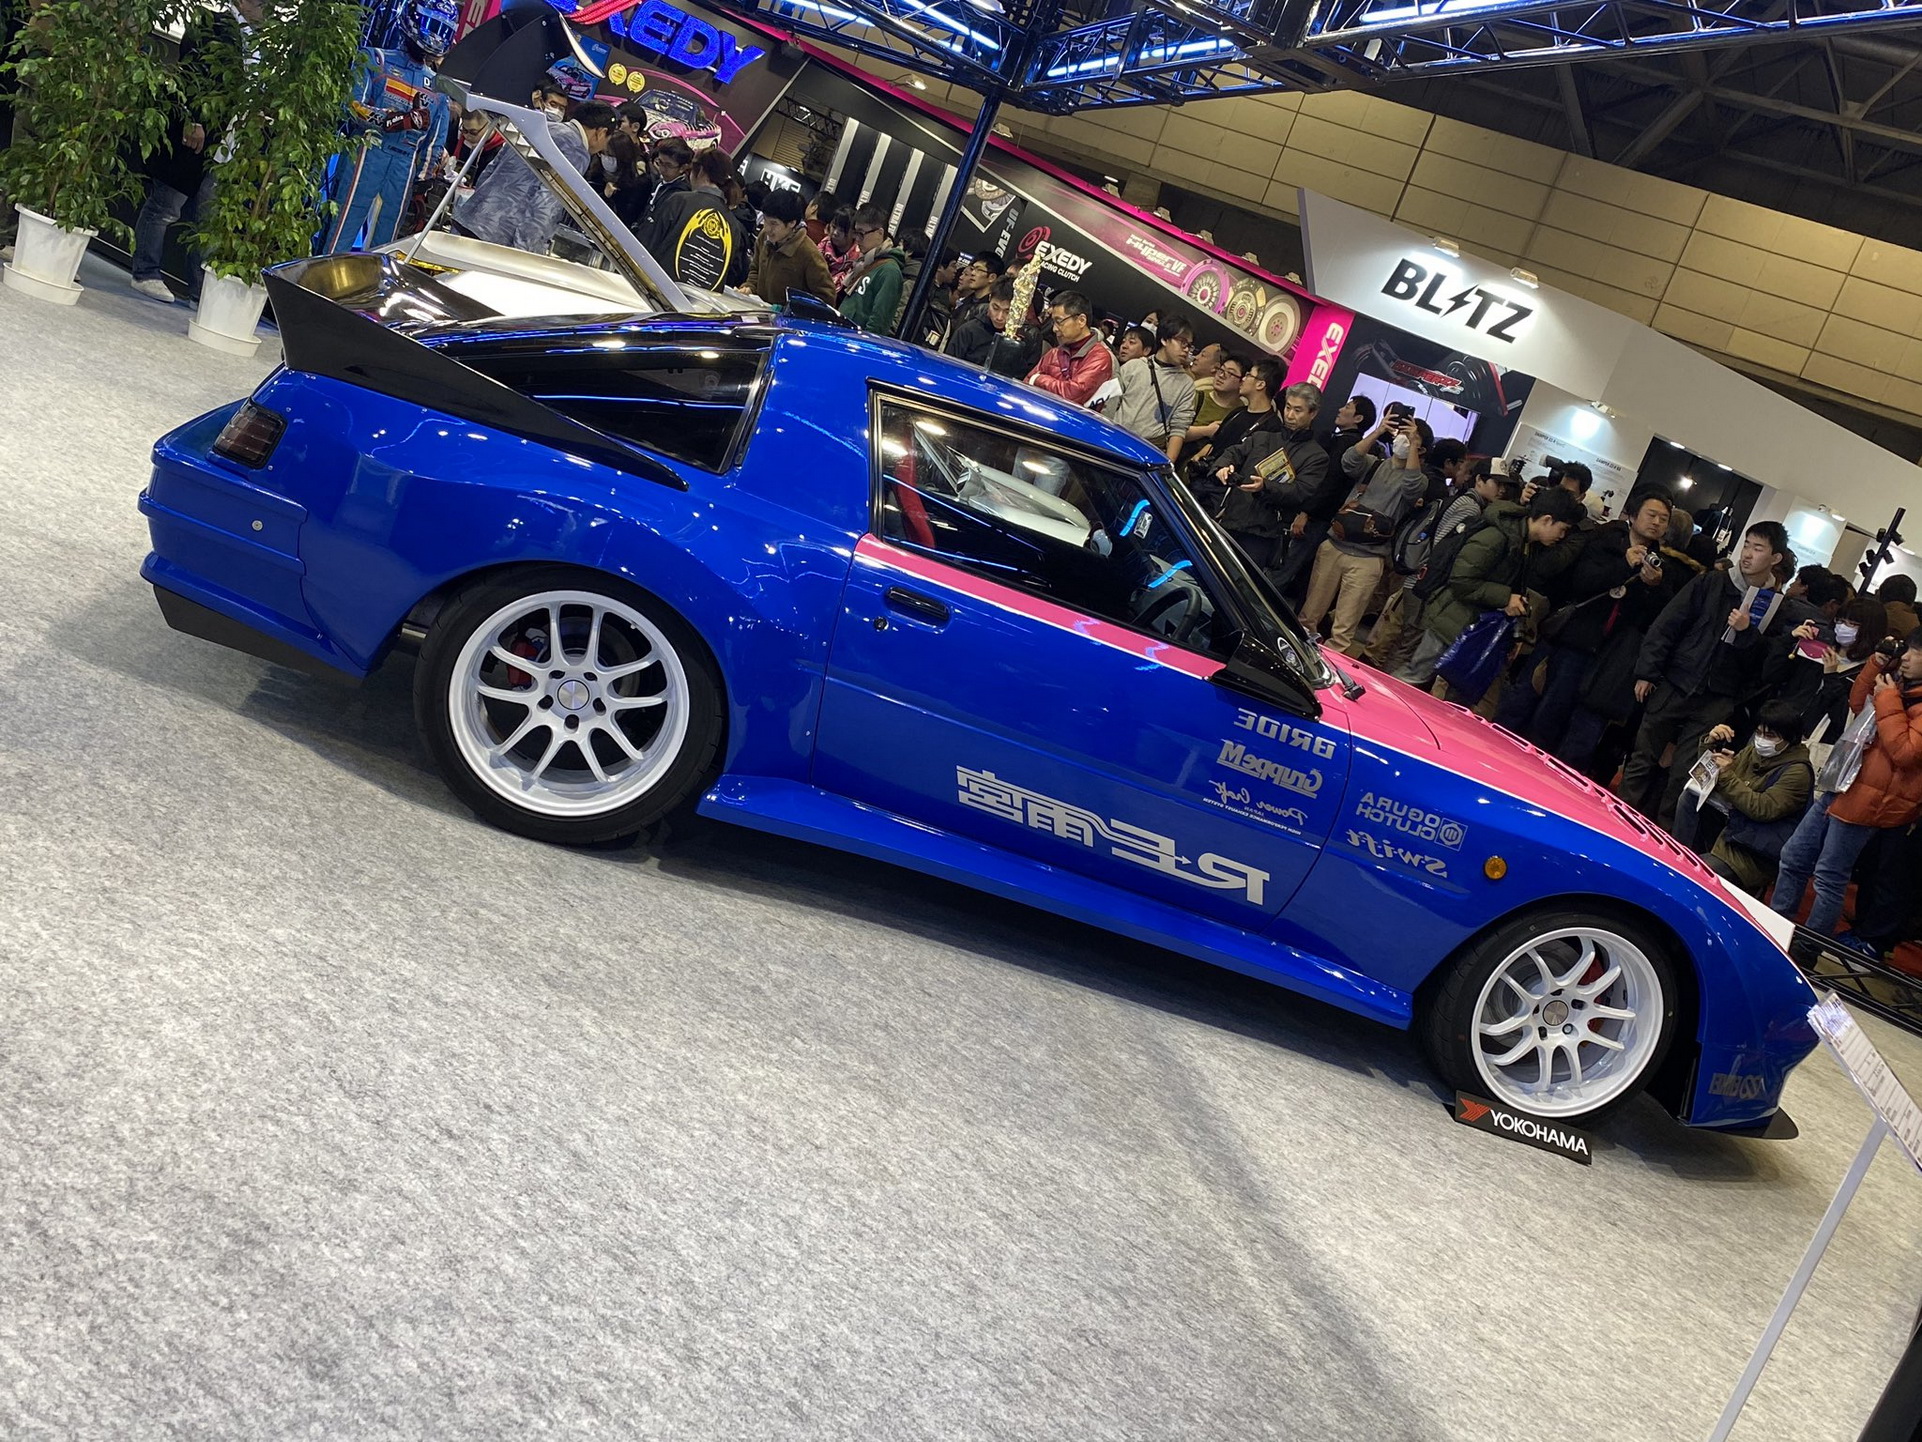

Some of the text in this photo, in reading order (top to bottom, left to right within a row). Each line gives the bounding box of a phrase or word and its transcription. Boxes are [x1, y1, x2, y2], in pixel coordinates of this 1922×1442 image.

[546, 0, 765, 84] XEDY
[1034, 240, 1093, 275] EXEDY
[1058, 266, 1080, 282] CLUTCH
[1380, 258, 1532, 342] BLITZ
[1306, 321, 1344, 392] EXED
[1489, 1108, 1589, 1157] YOKOHAMA
